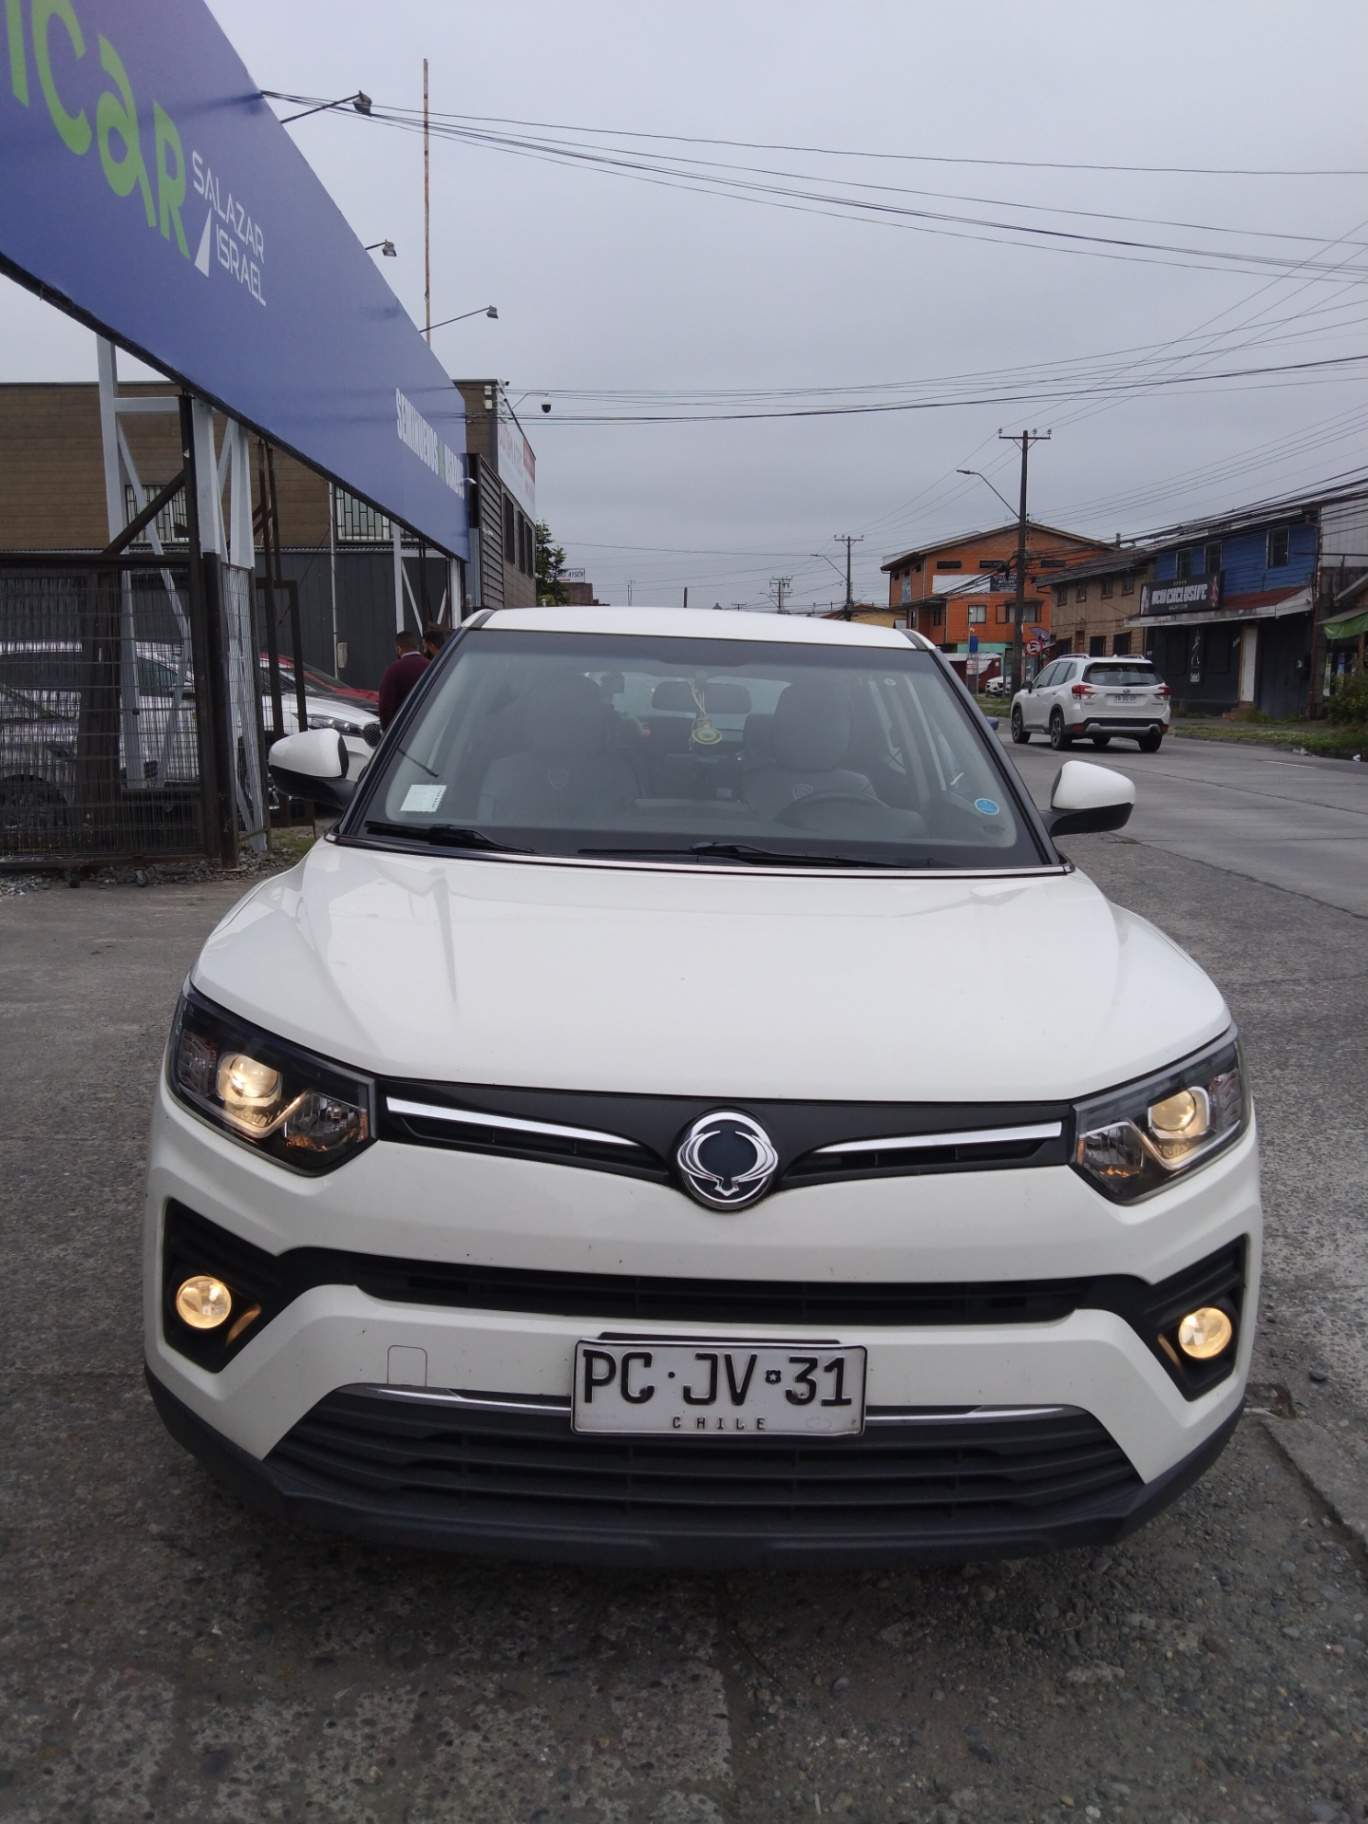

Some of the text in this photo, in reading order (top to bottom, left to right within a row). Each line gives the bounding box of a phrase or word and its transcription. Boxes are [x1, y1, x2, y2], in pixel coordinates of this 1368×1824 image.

[192, 150, 265, 264] SALAZAR
[216, 223, 266, 306] ISRAEL
[672, 1416, 767, 1431] CHILE
